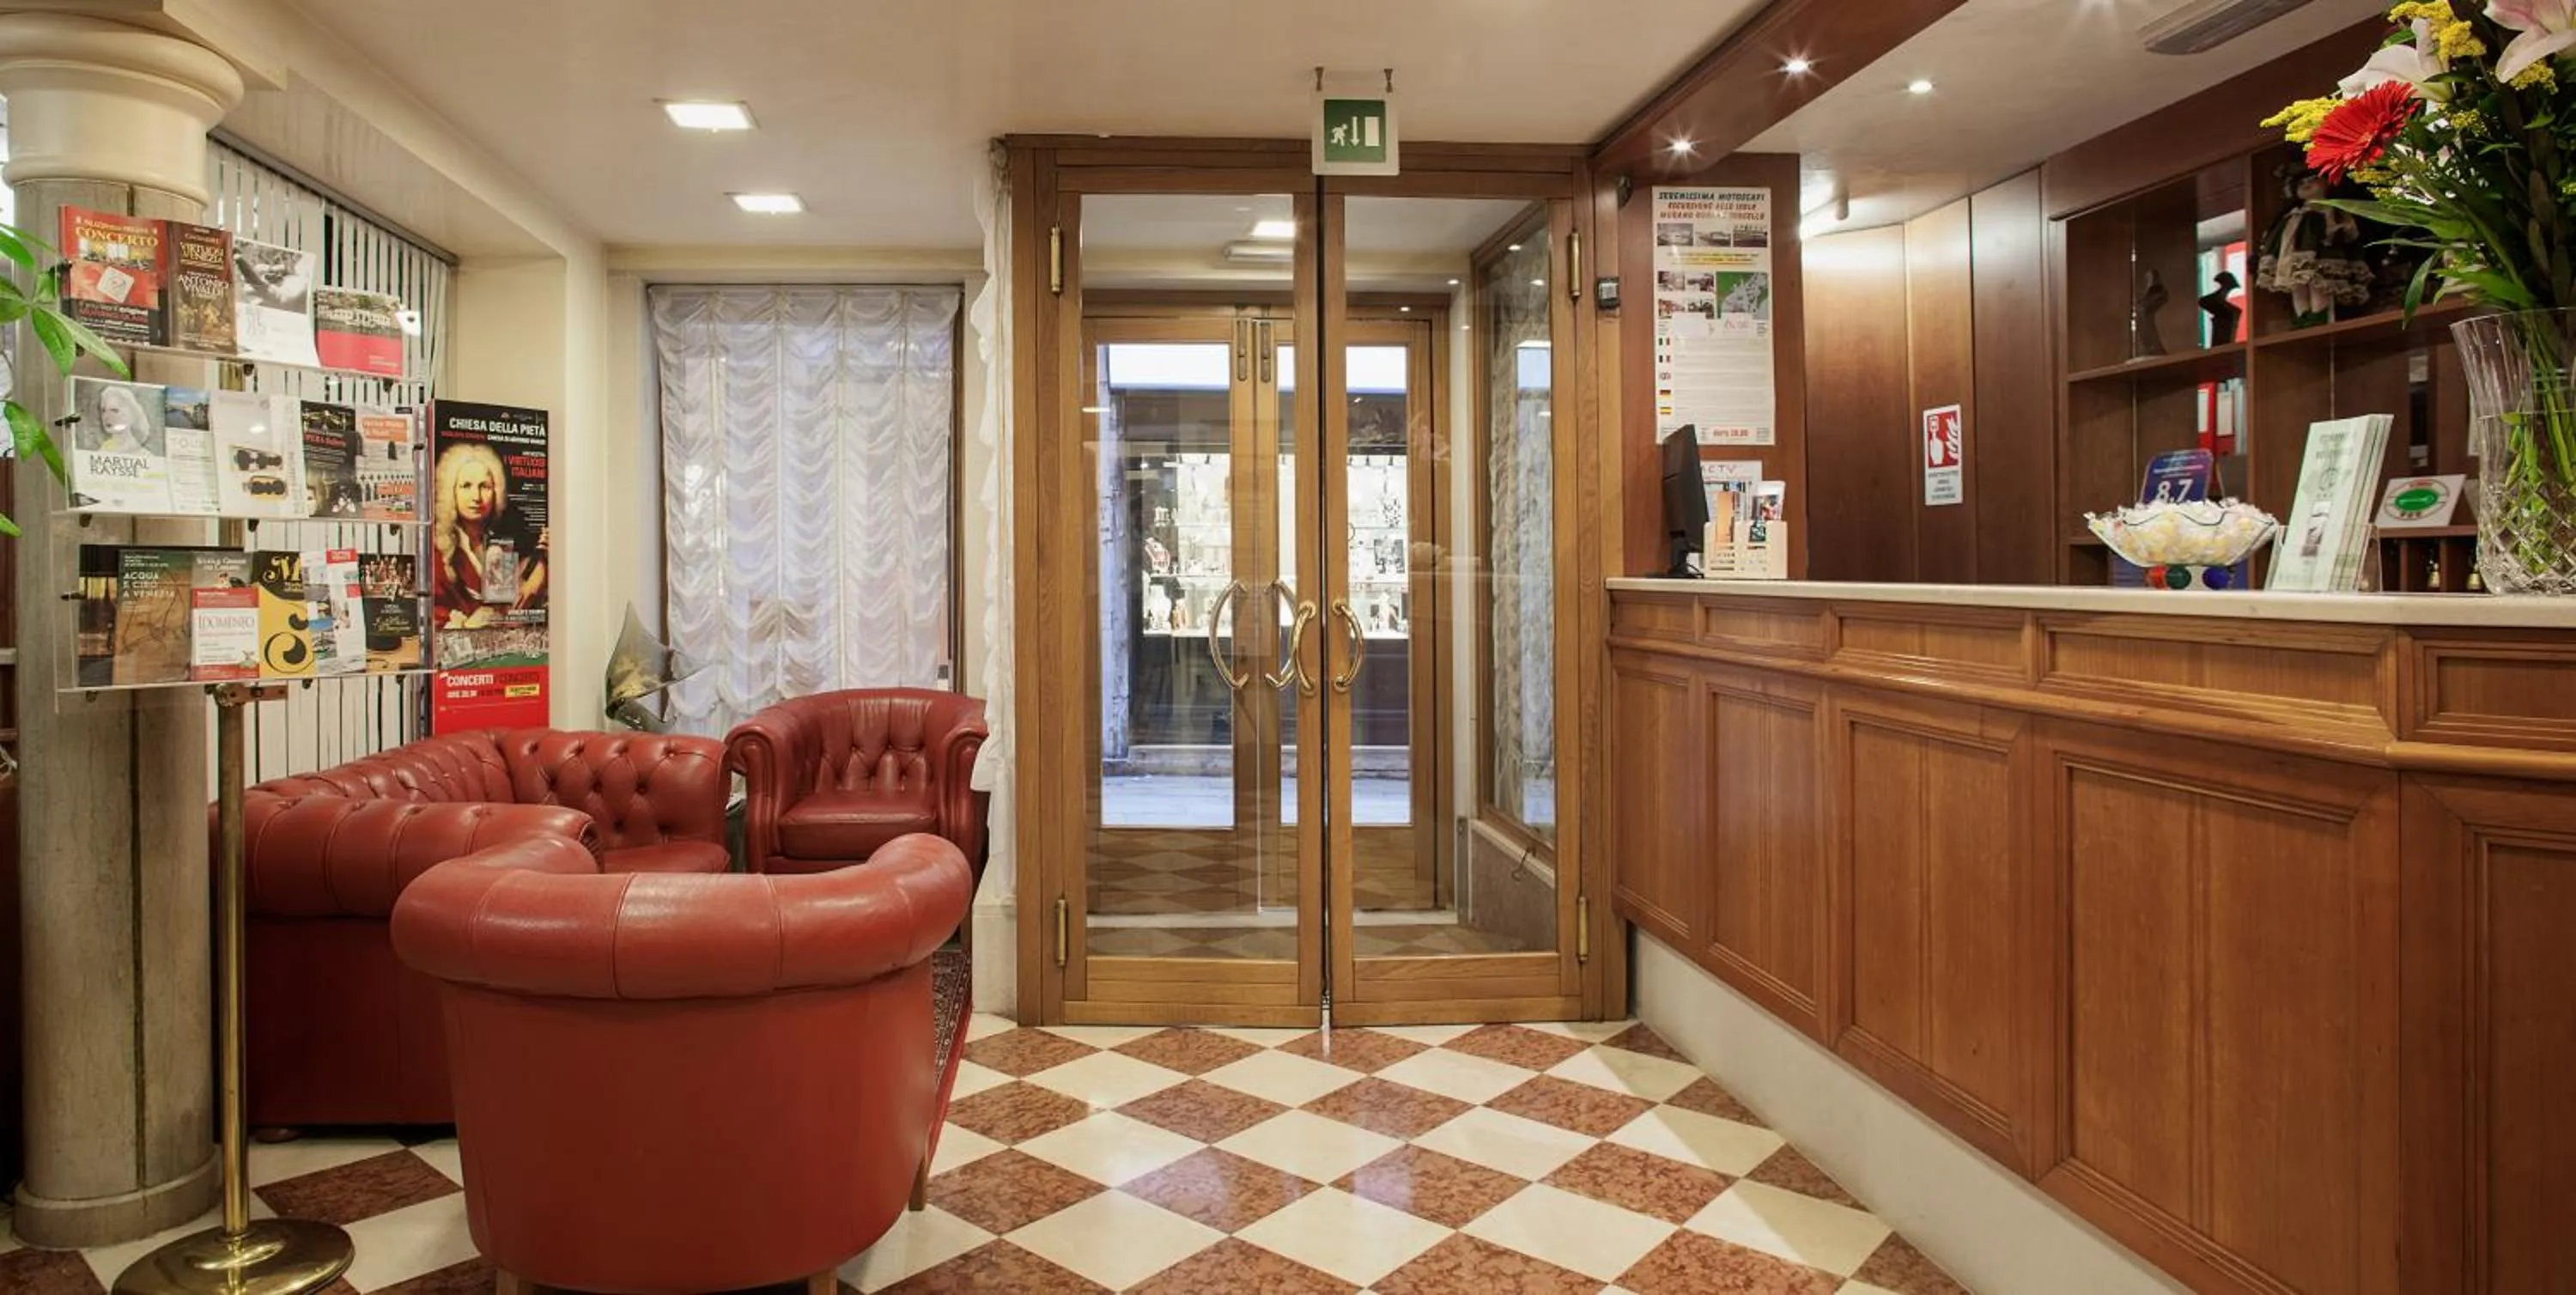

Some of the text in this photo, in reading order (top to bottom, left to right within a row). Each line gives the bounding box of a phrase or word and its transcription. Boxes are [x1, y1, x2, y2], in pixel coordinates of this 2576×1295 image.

[76, 226, 158, 246] CONCERTO
[179, 274, 228, 290] ANTONIO
[449, 417, 546, 436] CHIESA DELLA PIETÀ
[90, 455, 149, 469] MARTIAL
[124, 571, 159, 580] ACQUA
[447, 673, 494, 687] CONCERTI
